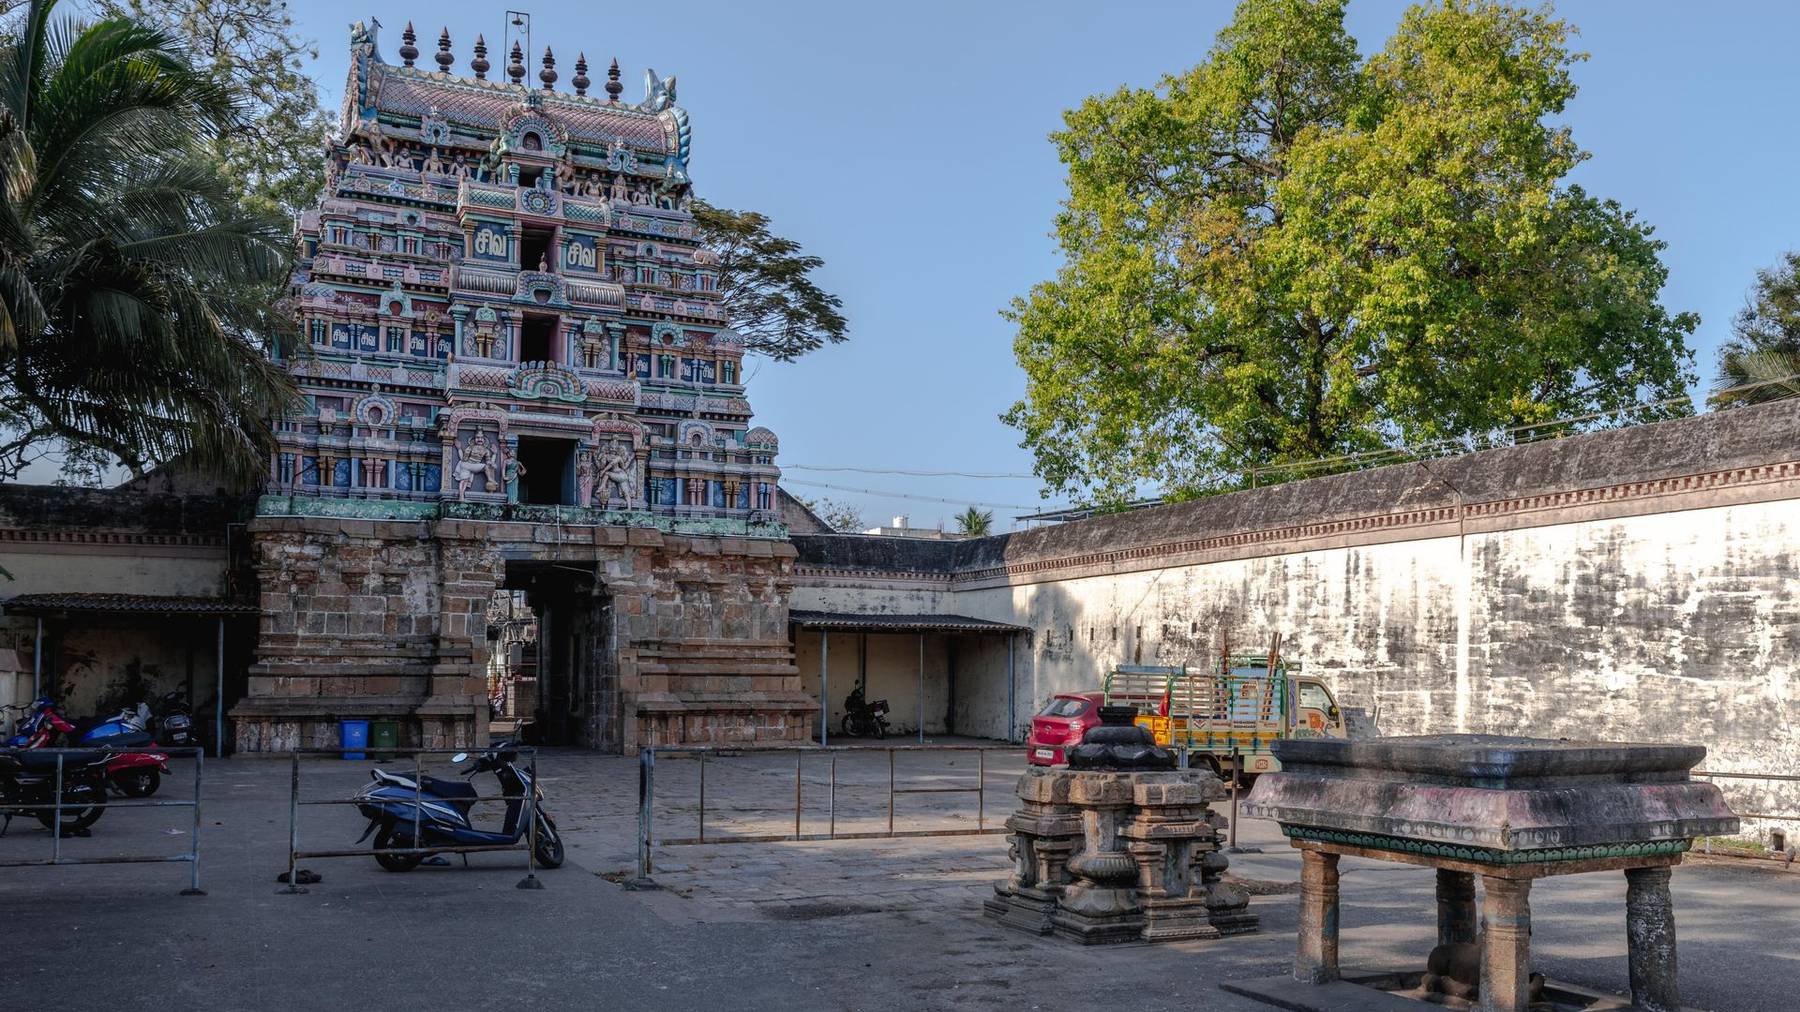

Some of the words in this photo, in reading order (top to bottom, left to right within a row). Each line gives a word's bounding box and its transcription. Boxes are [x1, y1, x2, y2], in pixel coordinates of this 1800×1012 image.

[475, 229, 506, 257] சிவ
[567, 242, 596, 267] சிவ
[333, 329, 348, 343] சிவ
[361, 333, 376, 346] சிவ
[411, 337, 425, 350] சிவ
